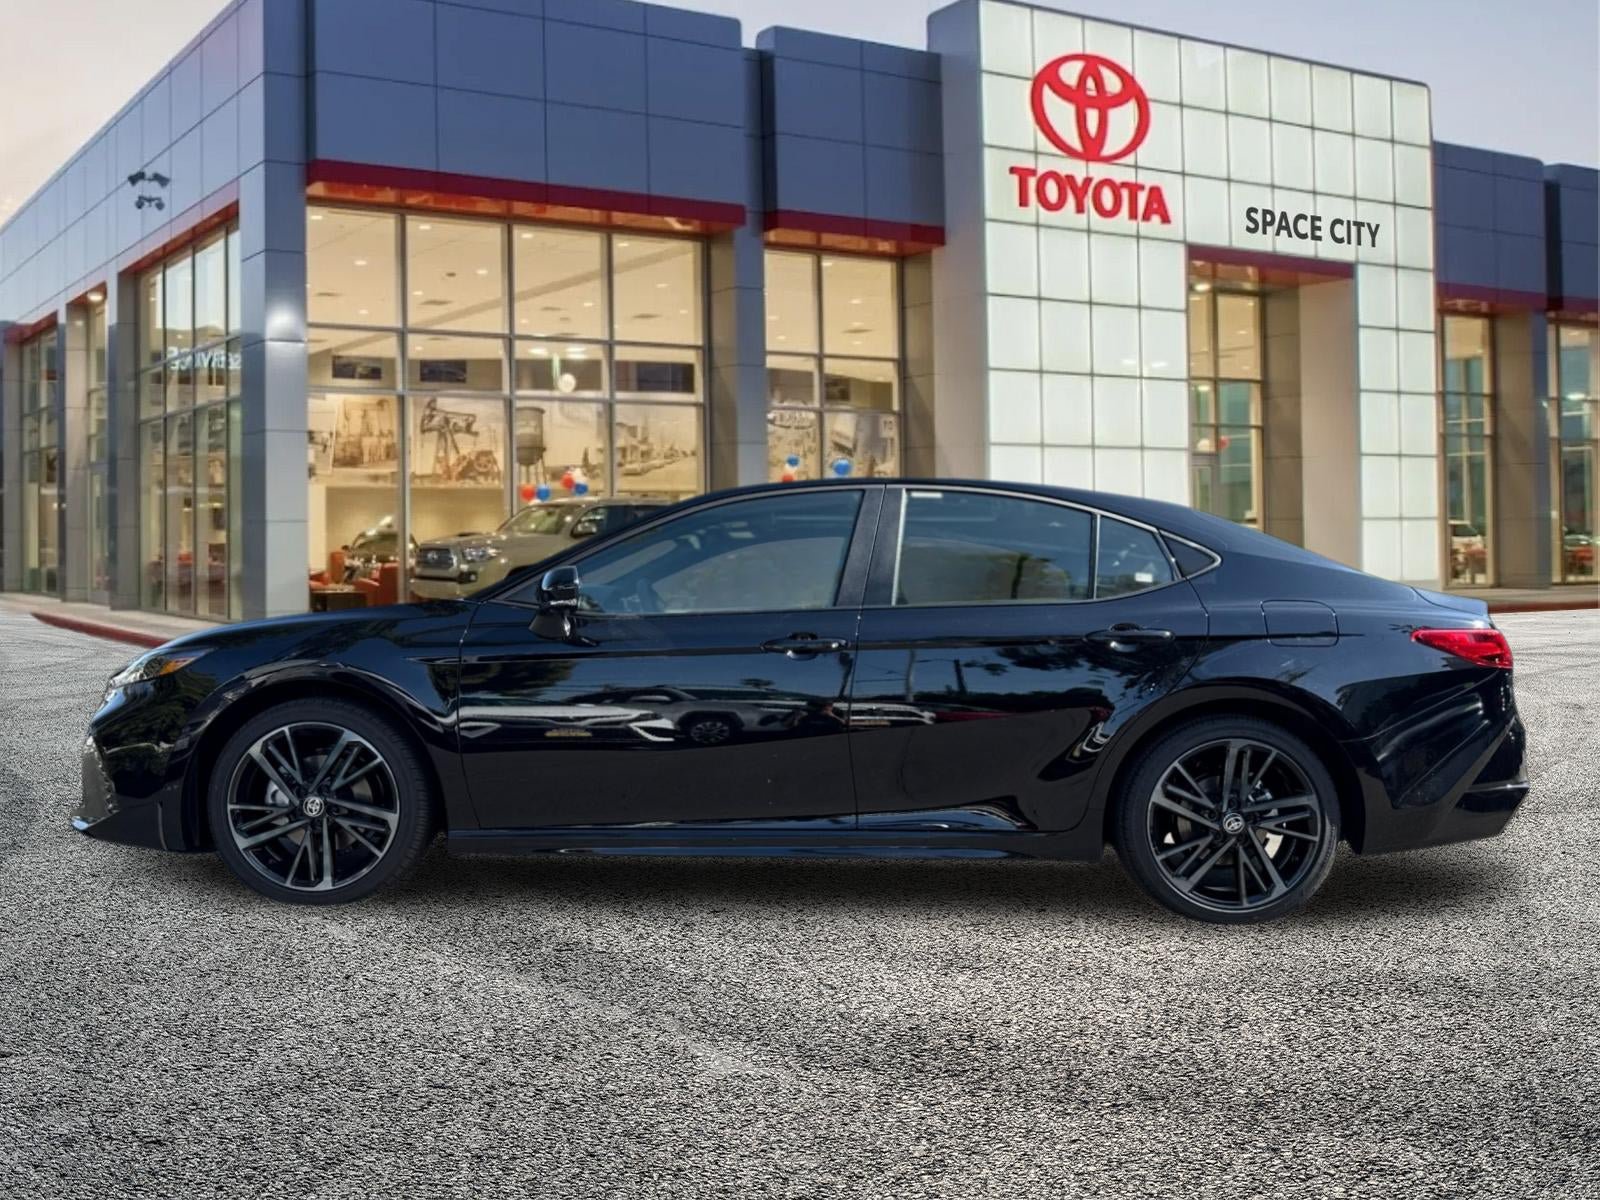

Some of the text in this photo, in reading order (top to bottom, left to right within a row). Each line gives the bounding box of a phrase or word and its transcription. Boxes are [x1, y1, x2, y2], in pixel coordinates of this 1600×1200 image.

[1009, 166, 1171, 224] TOYOTA
[1245, 206, 1381, 248] SPACE CITY
